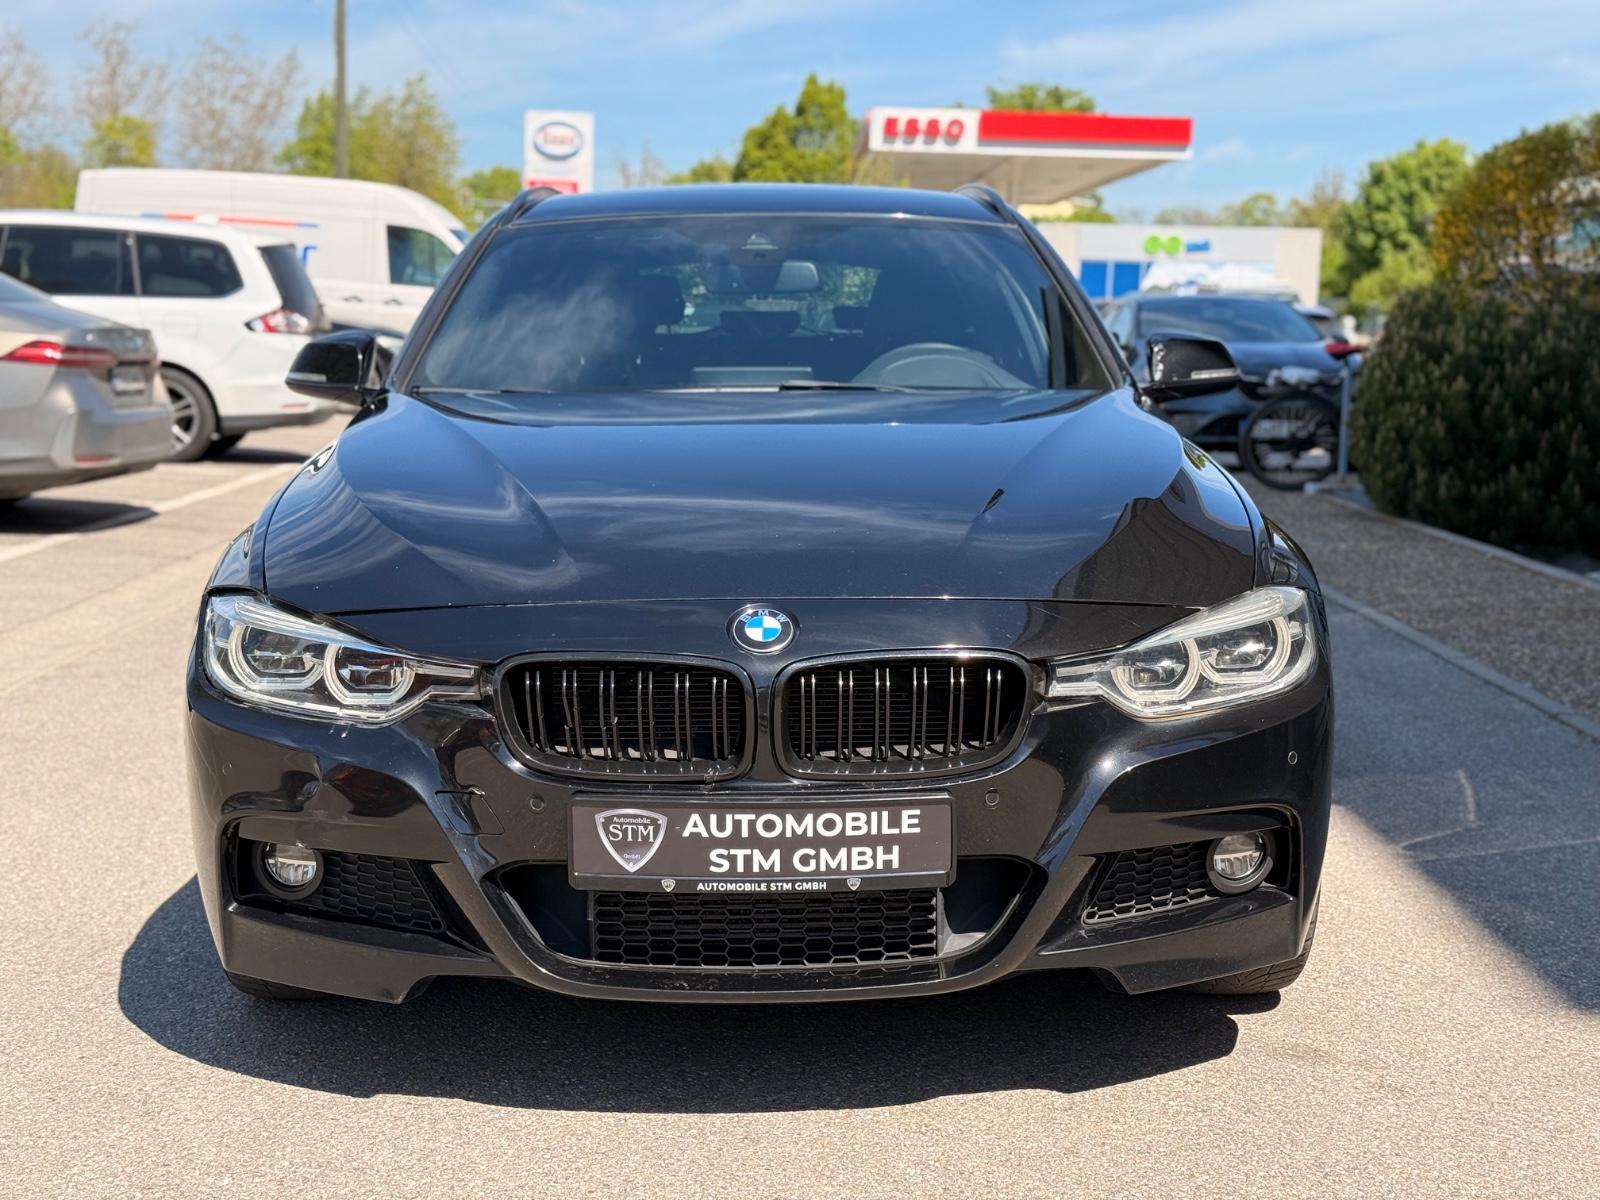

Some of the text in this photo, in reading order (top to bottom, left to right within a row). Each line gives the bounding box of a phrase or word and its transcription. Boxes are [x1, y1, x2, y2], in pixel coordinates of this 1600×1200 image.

[739, 610, 788, 622] BMW
[613, 816, 651, 824] Automobile
[682, 809, 921, 838] AUTOMOBILE
[608, 824, 656, 843] STM
[709, 845, 900, 873] STM GMBH
[697, 881, 827, 891] AUTOMOBILE STM GMBH
